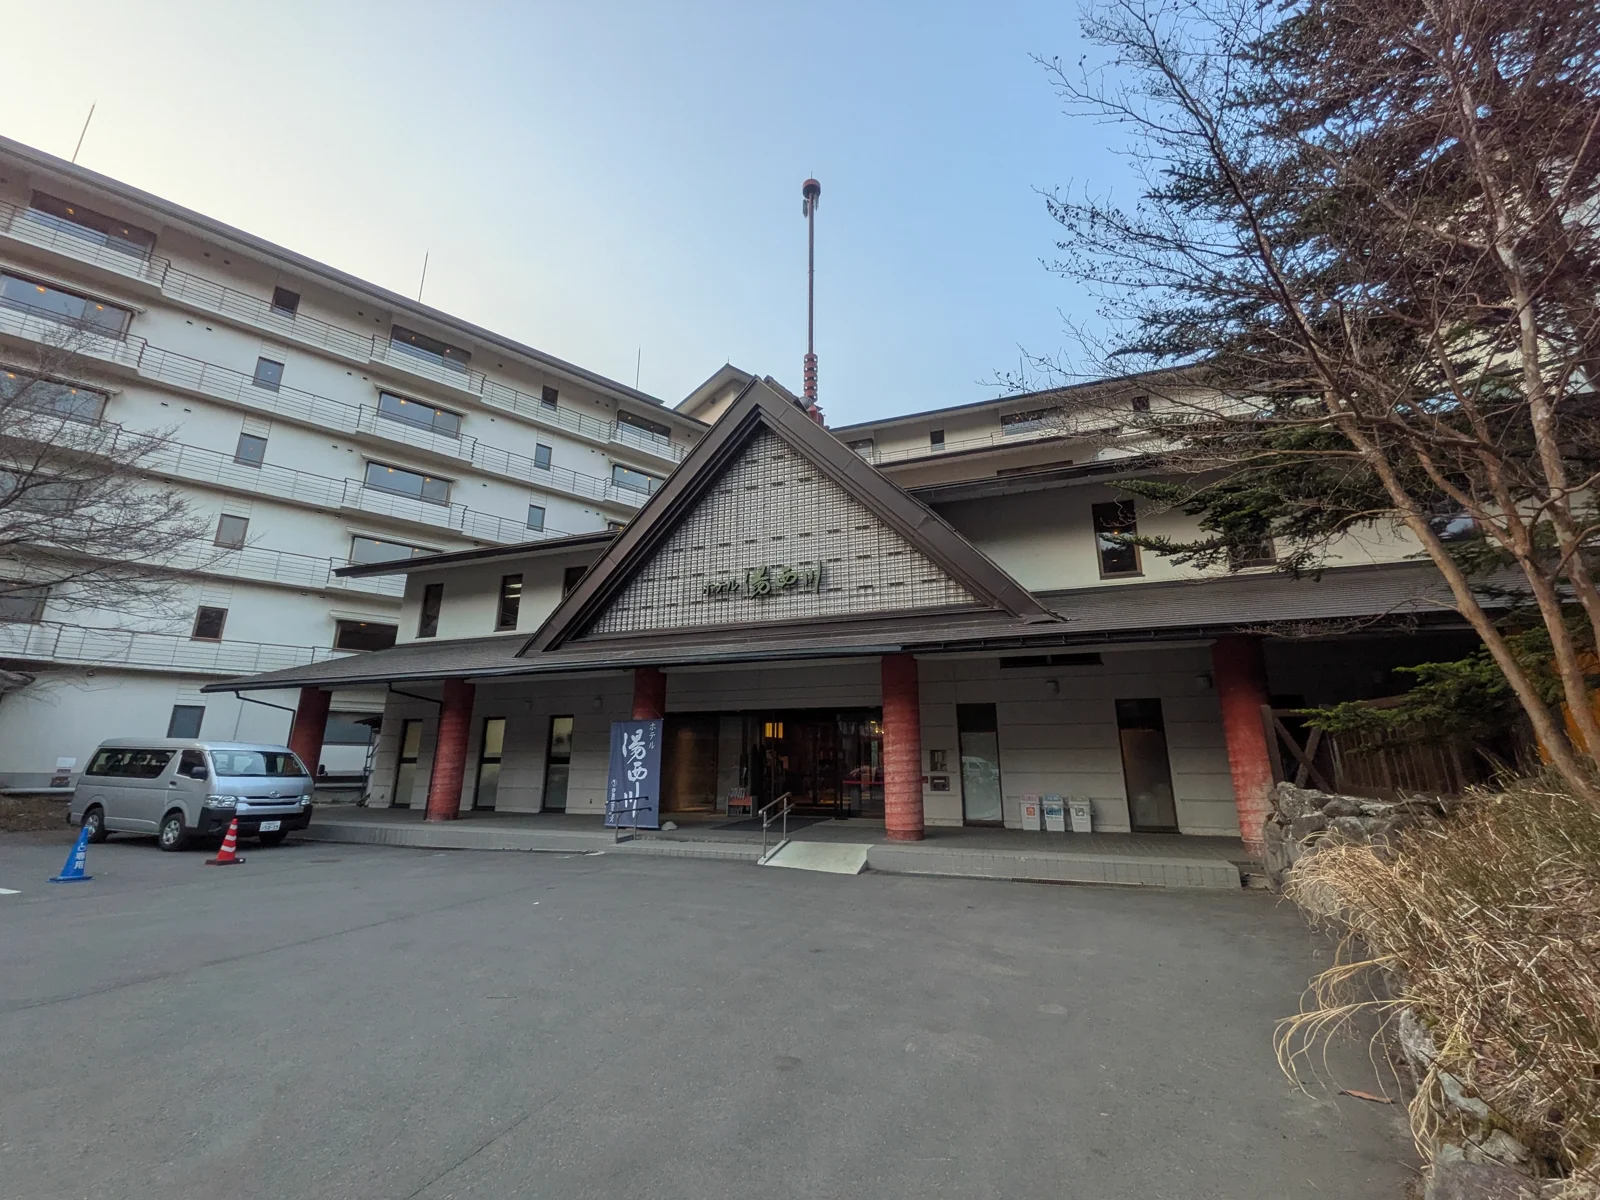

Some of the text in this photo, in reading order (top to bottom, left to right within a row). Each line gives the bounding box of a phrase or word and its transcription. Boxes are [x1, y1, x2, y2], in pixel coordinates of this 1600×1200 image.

[703, 560, 821, 600] ホテル 湯西川
[648, 722, 657, 750] ホテル
[622, 728, 648, 819] 湯西川
